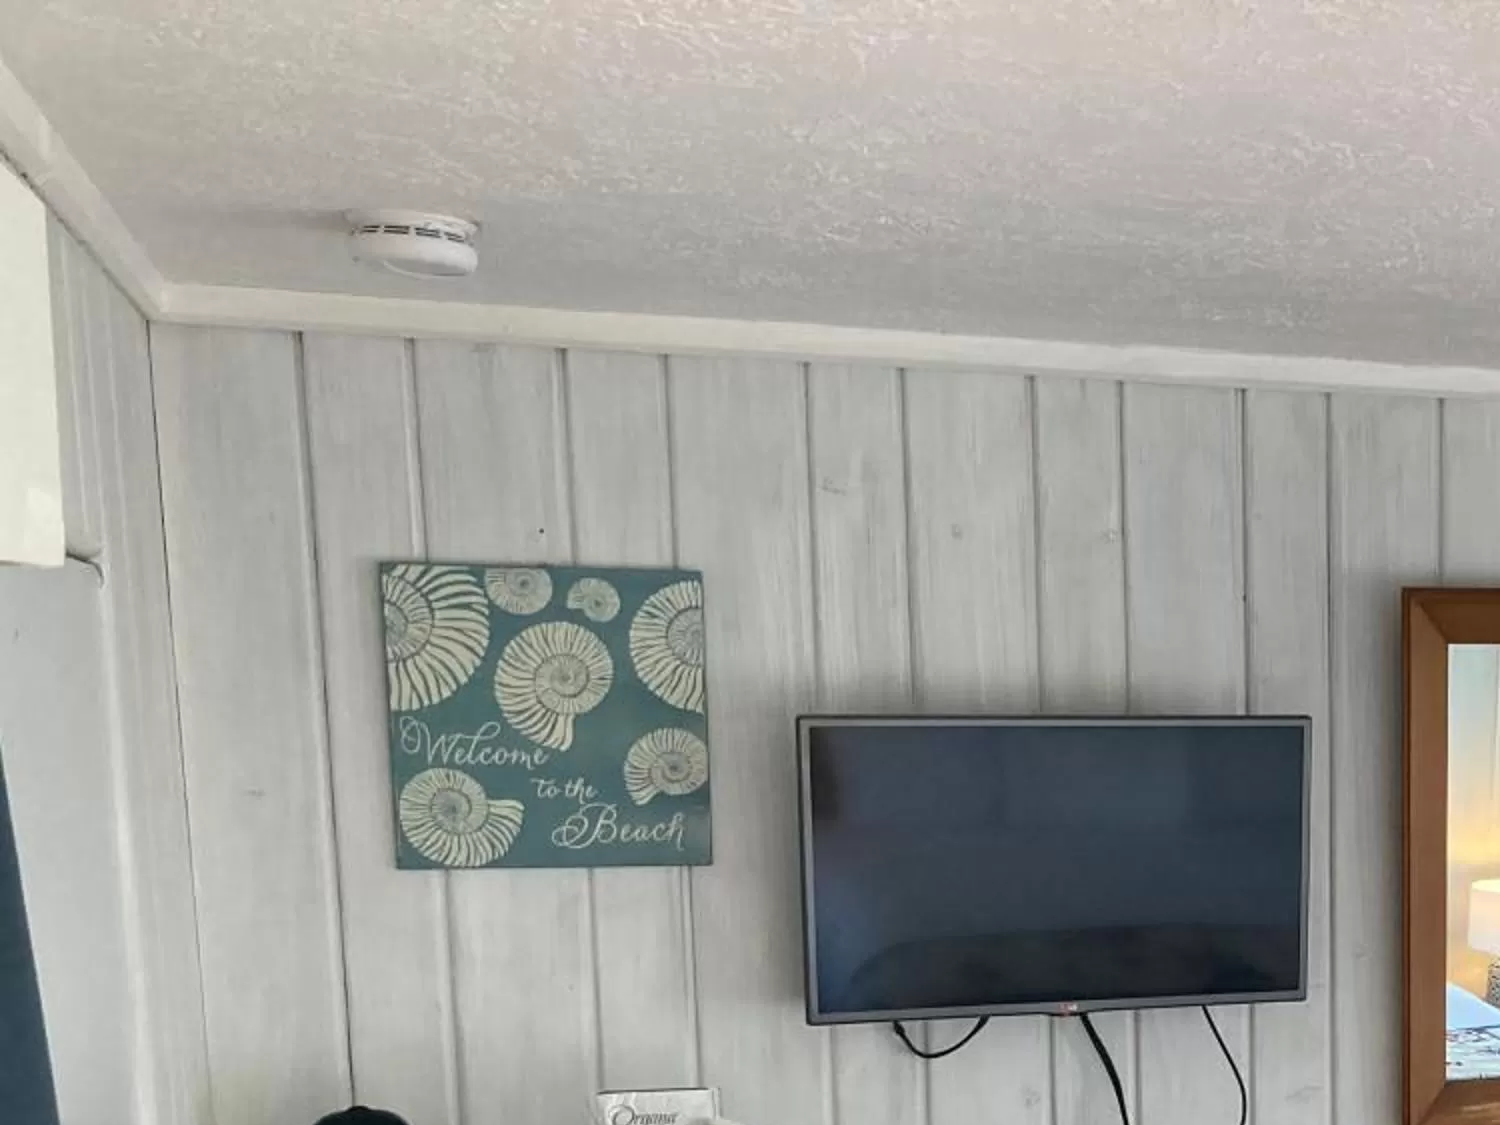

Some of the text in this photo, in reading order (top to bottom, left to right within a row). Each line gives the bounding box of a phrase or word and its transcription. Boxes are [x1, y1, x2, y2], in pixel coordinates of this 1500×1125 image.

[399, 715, 549, 770] Welcome
[531, 776, 598, 804] to the
[552, 802, 684, 851] Beach
